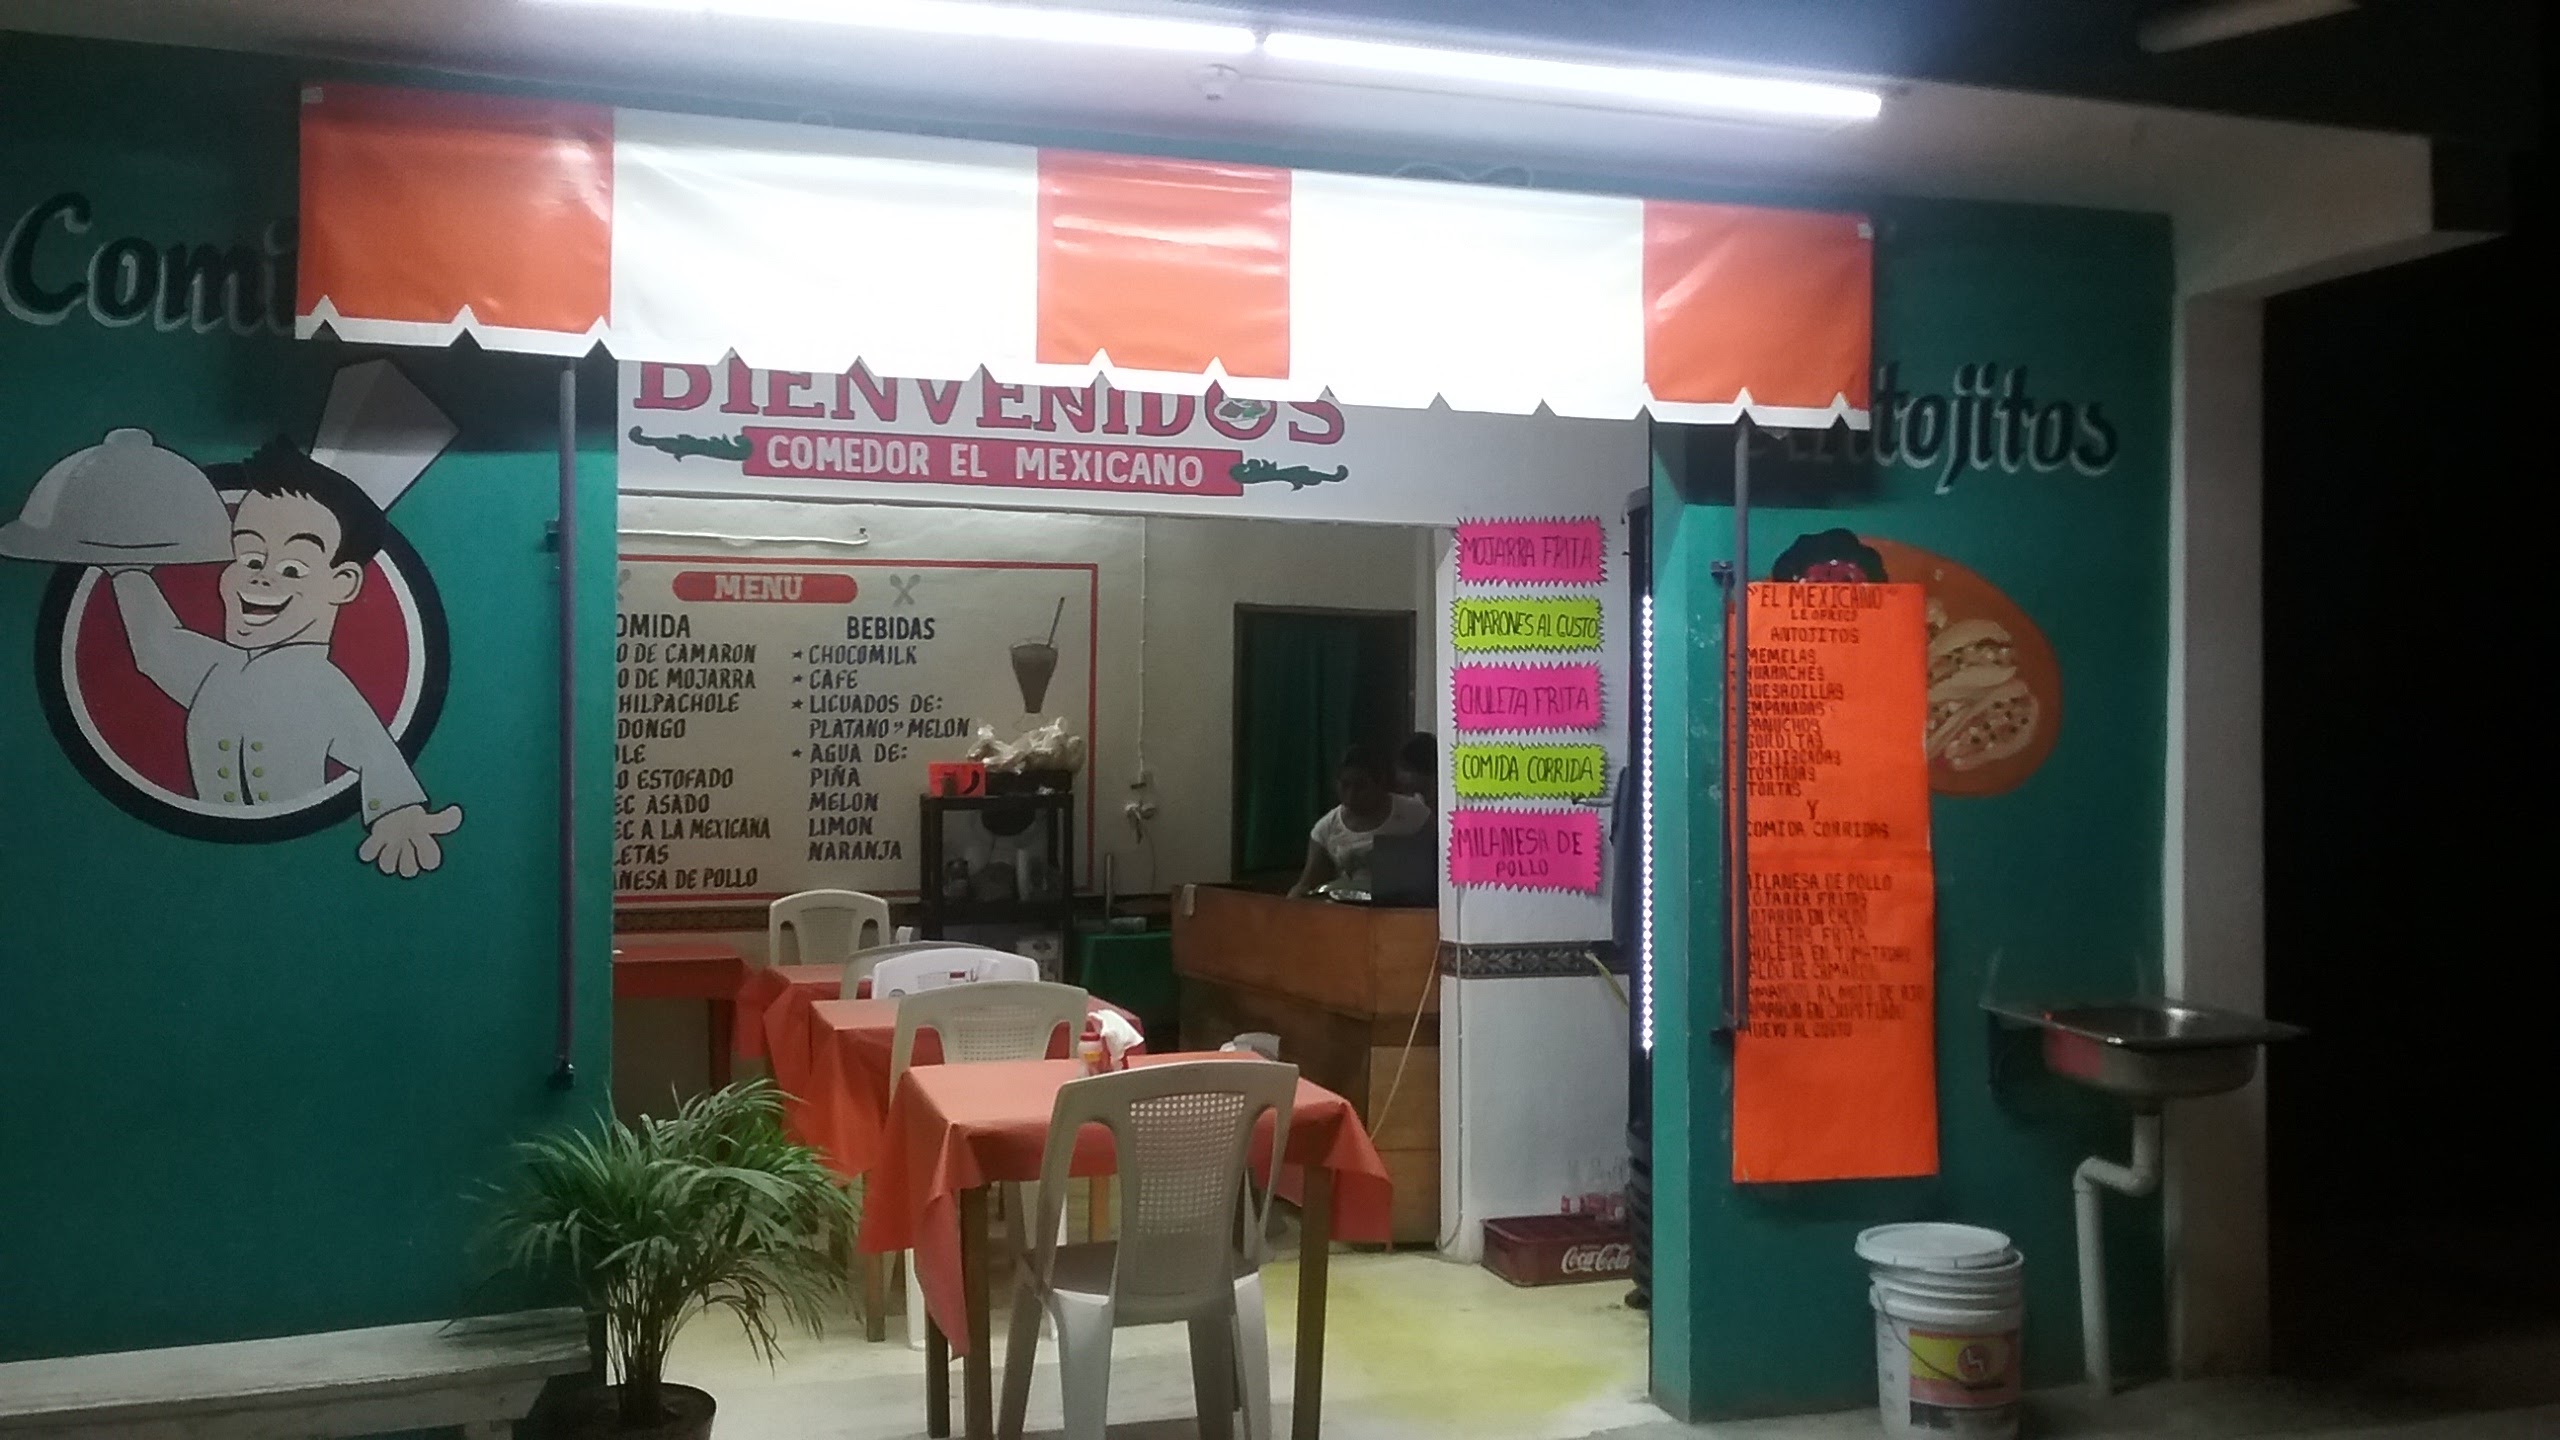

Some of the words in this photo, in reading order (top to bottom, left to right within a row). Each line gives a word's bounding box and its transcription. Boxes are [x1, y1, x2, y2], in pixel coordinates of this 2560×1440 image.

[1745, 362, 2119, 494] tojitos
[767, 435, 930, 476] COMEDOR
[950, 444, 988, 478] EL
[1015, 446, 1204, 487] MEXICANO
[1462, 536, 1535, 567] MOJARRA
[1541, 535, 1593, 569] FRITA
[714, 574, 803, 599] MENU
[847, 615, 936, 640] BEBIDAS
[1458, 607, 1534, 638] CAMARONES
[1536, 613, 1552, 637] AL
[1556, 613, 1599, 638] GUSTO
[1771, 626, 1860, 645] ANTOJITOS
[634, 643, 658, 663] DE
[665, 643, 757, 663] CAMARON
[808, 644, 917, 666] CHOCOMILK
[1748, 648, 1816, 665] MEMELAS
[635, 668, 659, 689] DE
[666, 668, 756, 689] MOJARRA
[809, 669, 858, 690] CAFE
[618, 692, 740, 713] HILPACHOLE
[809, 694, 900, 714] LICUADOS
[909, 694, 943, 714] DE:
[1533, 686, 1589, 716] FRITA
[618, 718, 686, 740] DONGO
[809, 718, 890, 739] PLATANO
[906, 717, 970, 739] MELON
[809, 743, 862, 764] AGUA
[874, 743, 908, 764] DE:
[637, 768, 734, 790] ESTOFADO
[809, 764, 861, 788] PIÑA
[1462, 754, 1519, 782] COMIDA
[1527, 756, 1594, 784] CORRIDA
[646, 793, 710, 815] ASADO
[808, 792, 880, 813] MELON
[1806, 799, 1820, 820] Y
[641, 819, 654, 840] A
[661, 819, 684, 840] LA
[689, 817, 771, 839] MEXICANA
[808, 816, 873, 838] LIMON
[807, 840, 903, 862] NARANJA
[1457, 827, 1549, 858] MILANESA
[1557, 829, 1583, 856] DE
[675, 868, 698, 889] DE
[703, 868, 758, 888] POLLO
[1496, 859, 1548, 878] POLLO
